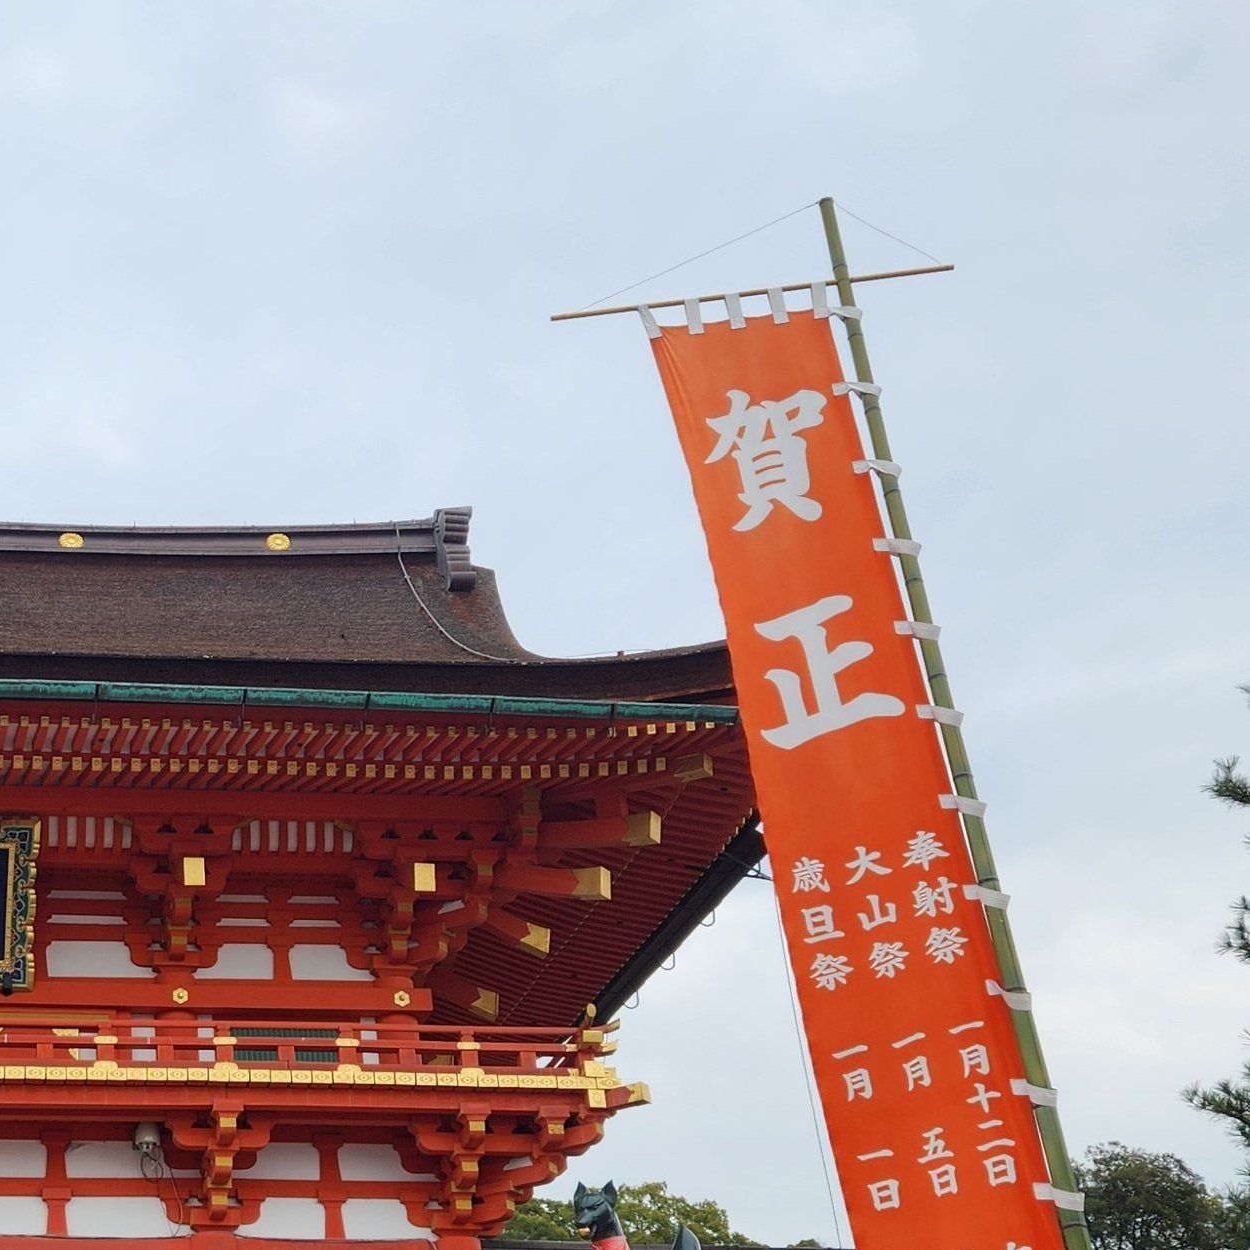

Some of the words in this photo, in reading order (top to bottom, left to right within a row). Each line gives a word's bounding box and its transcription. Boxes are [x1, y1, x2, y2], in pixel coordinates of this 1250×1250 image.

[704, 389, 905, 750] 賀正
[792, 857, 853, 991] 歳旦祭
[846, 846, 909, 978] 大山祭
[904, 830, 967, 964] 奉射祭
[949, 1020, 1017, 1187] 一月十二日
